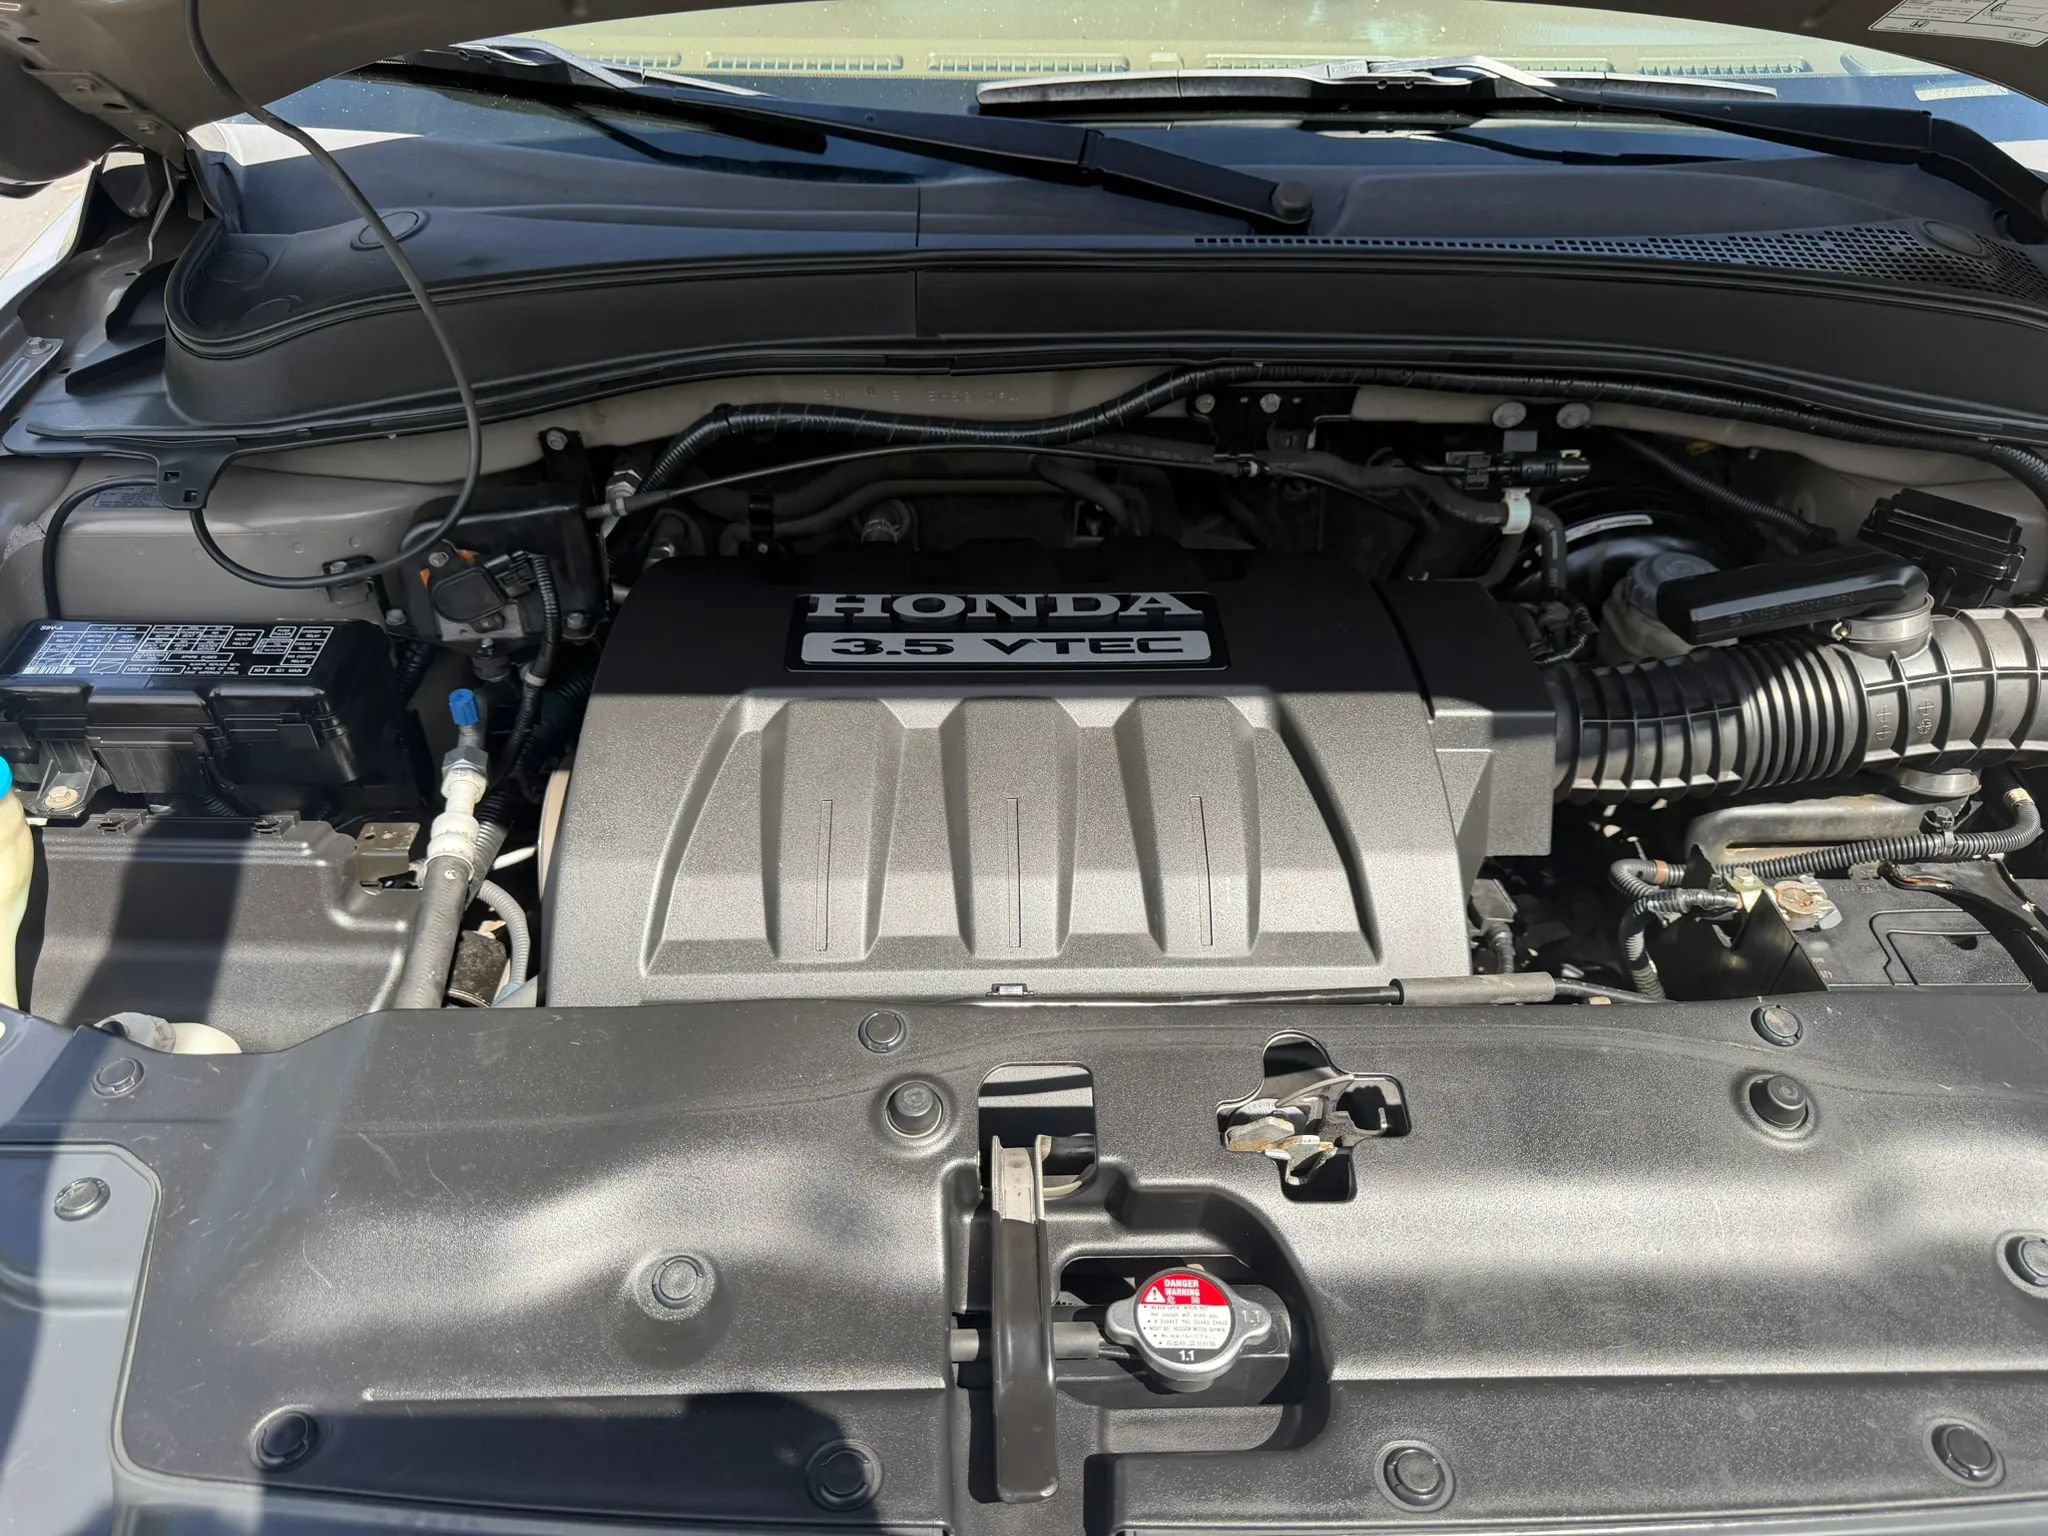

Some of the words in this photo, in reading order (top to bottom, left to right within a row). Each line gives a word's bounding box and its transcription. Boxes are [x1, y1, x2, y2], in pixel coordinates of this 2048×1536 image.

[806, 592, 1204, 618] HONDA
[831, 637, 955, 656] 3.5
[982, 637, 1184, 656] VTEC
[1164, 1279, 1199, 1287] DANGER
[1165, 1288, 1200, 1297] WARNING
[1179, 1350, 1194, 1361] 1.1
